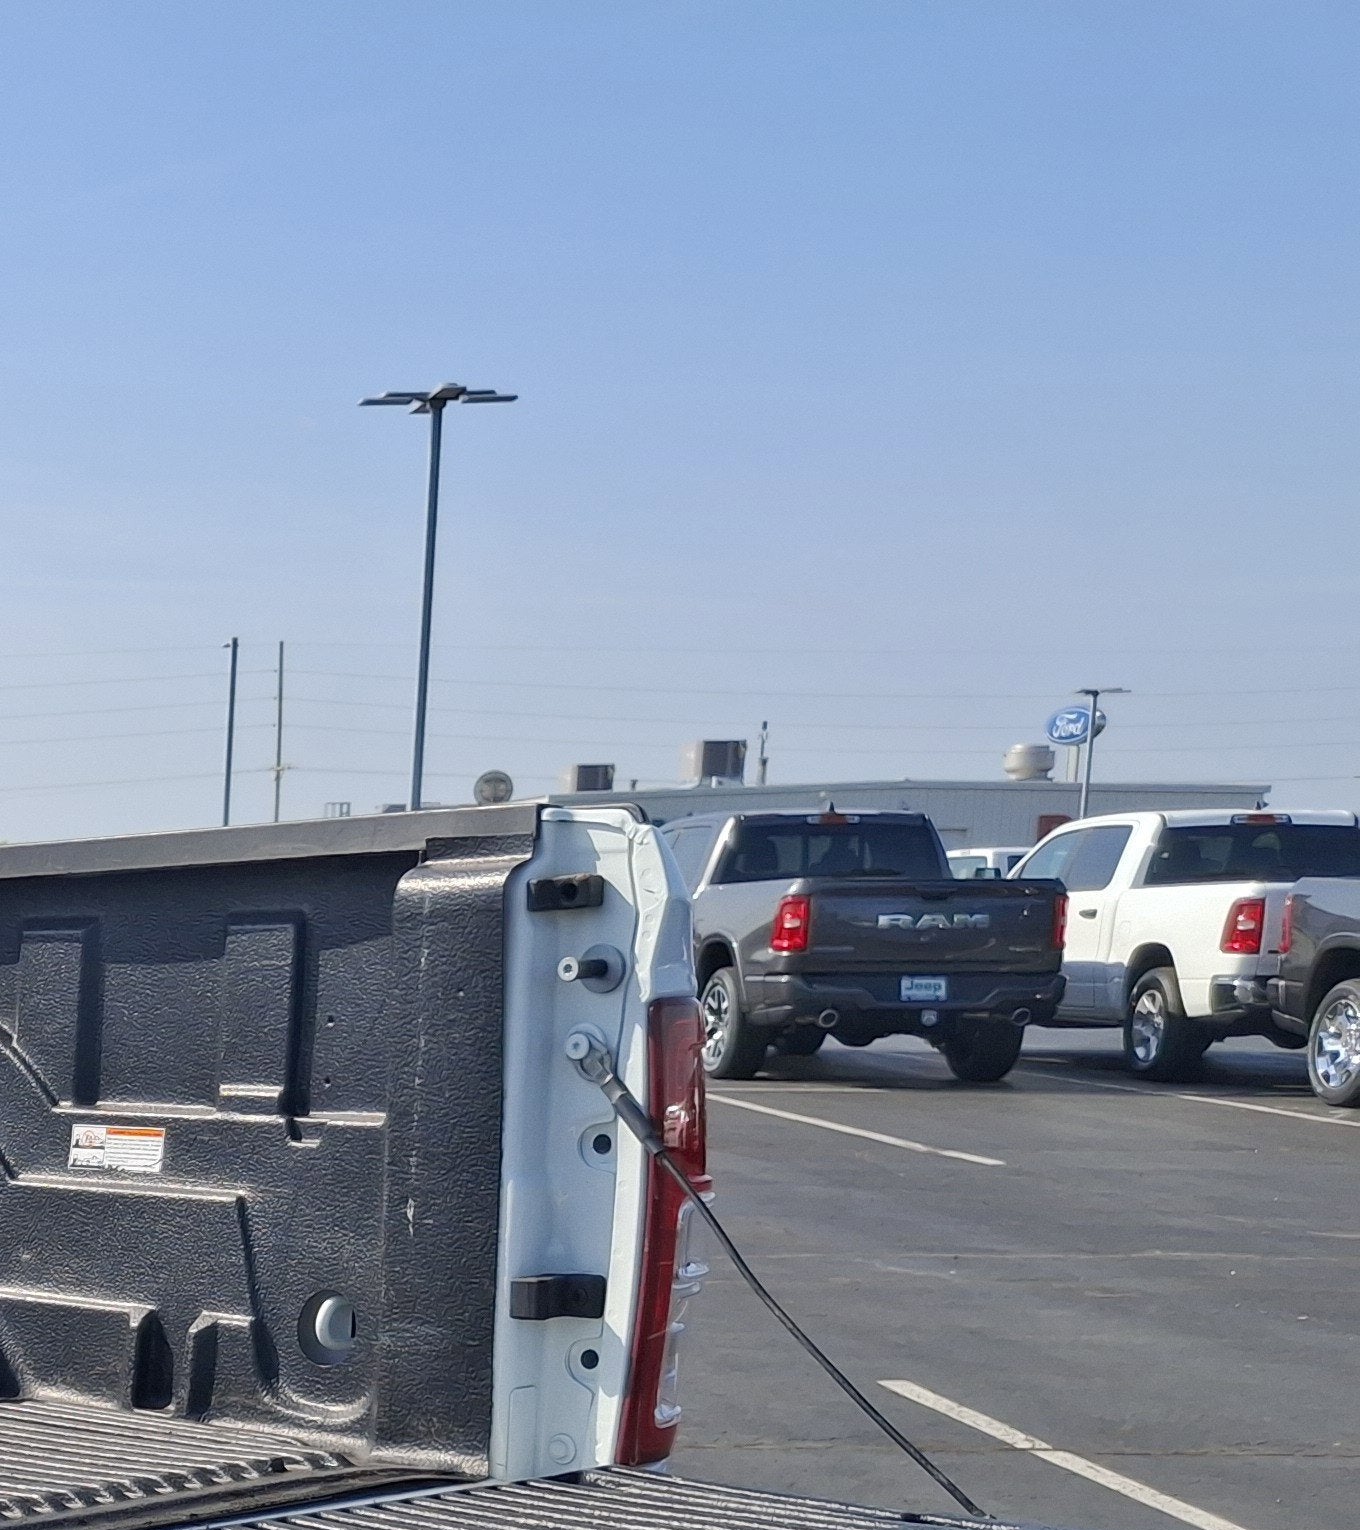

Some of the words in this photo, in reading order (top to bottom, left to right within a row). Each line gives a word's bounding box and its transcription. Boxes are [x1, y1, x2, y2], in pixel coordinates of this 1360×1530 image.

[1052, 712, 1085, 738] Ford
[877, 913, 990, 929] RAM
[905, 980, 942, 993] Jeep
